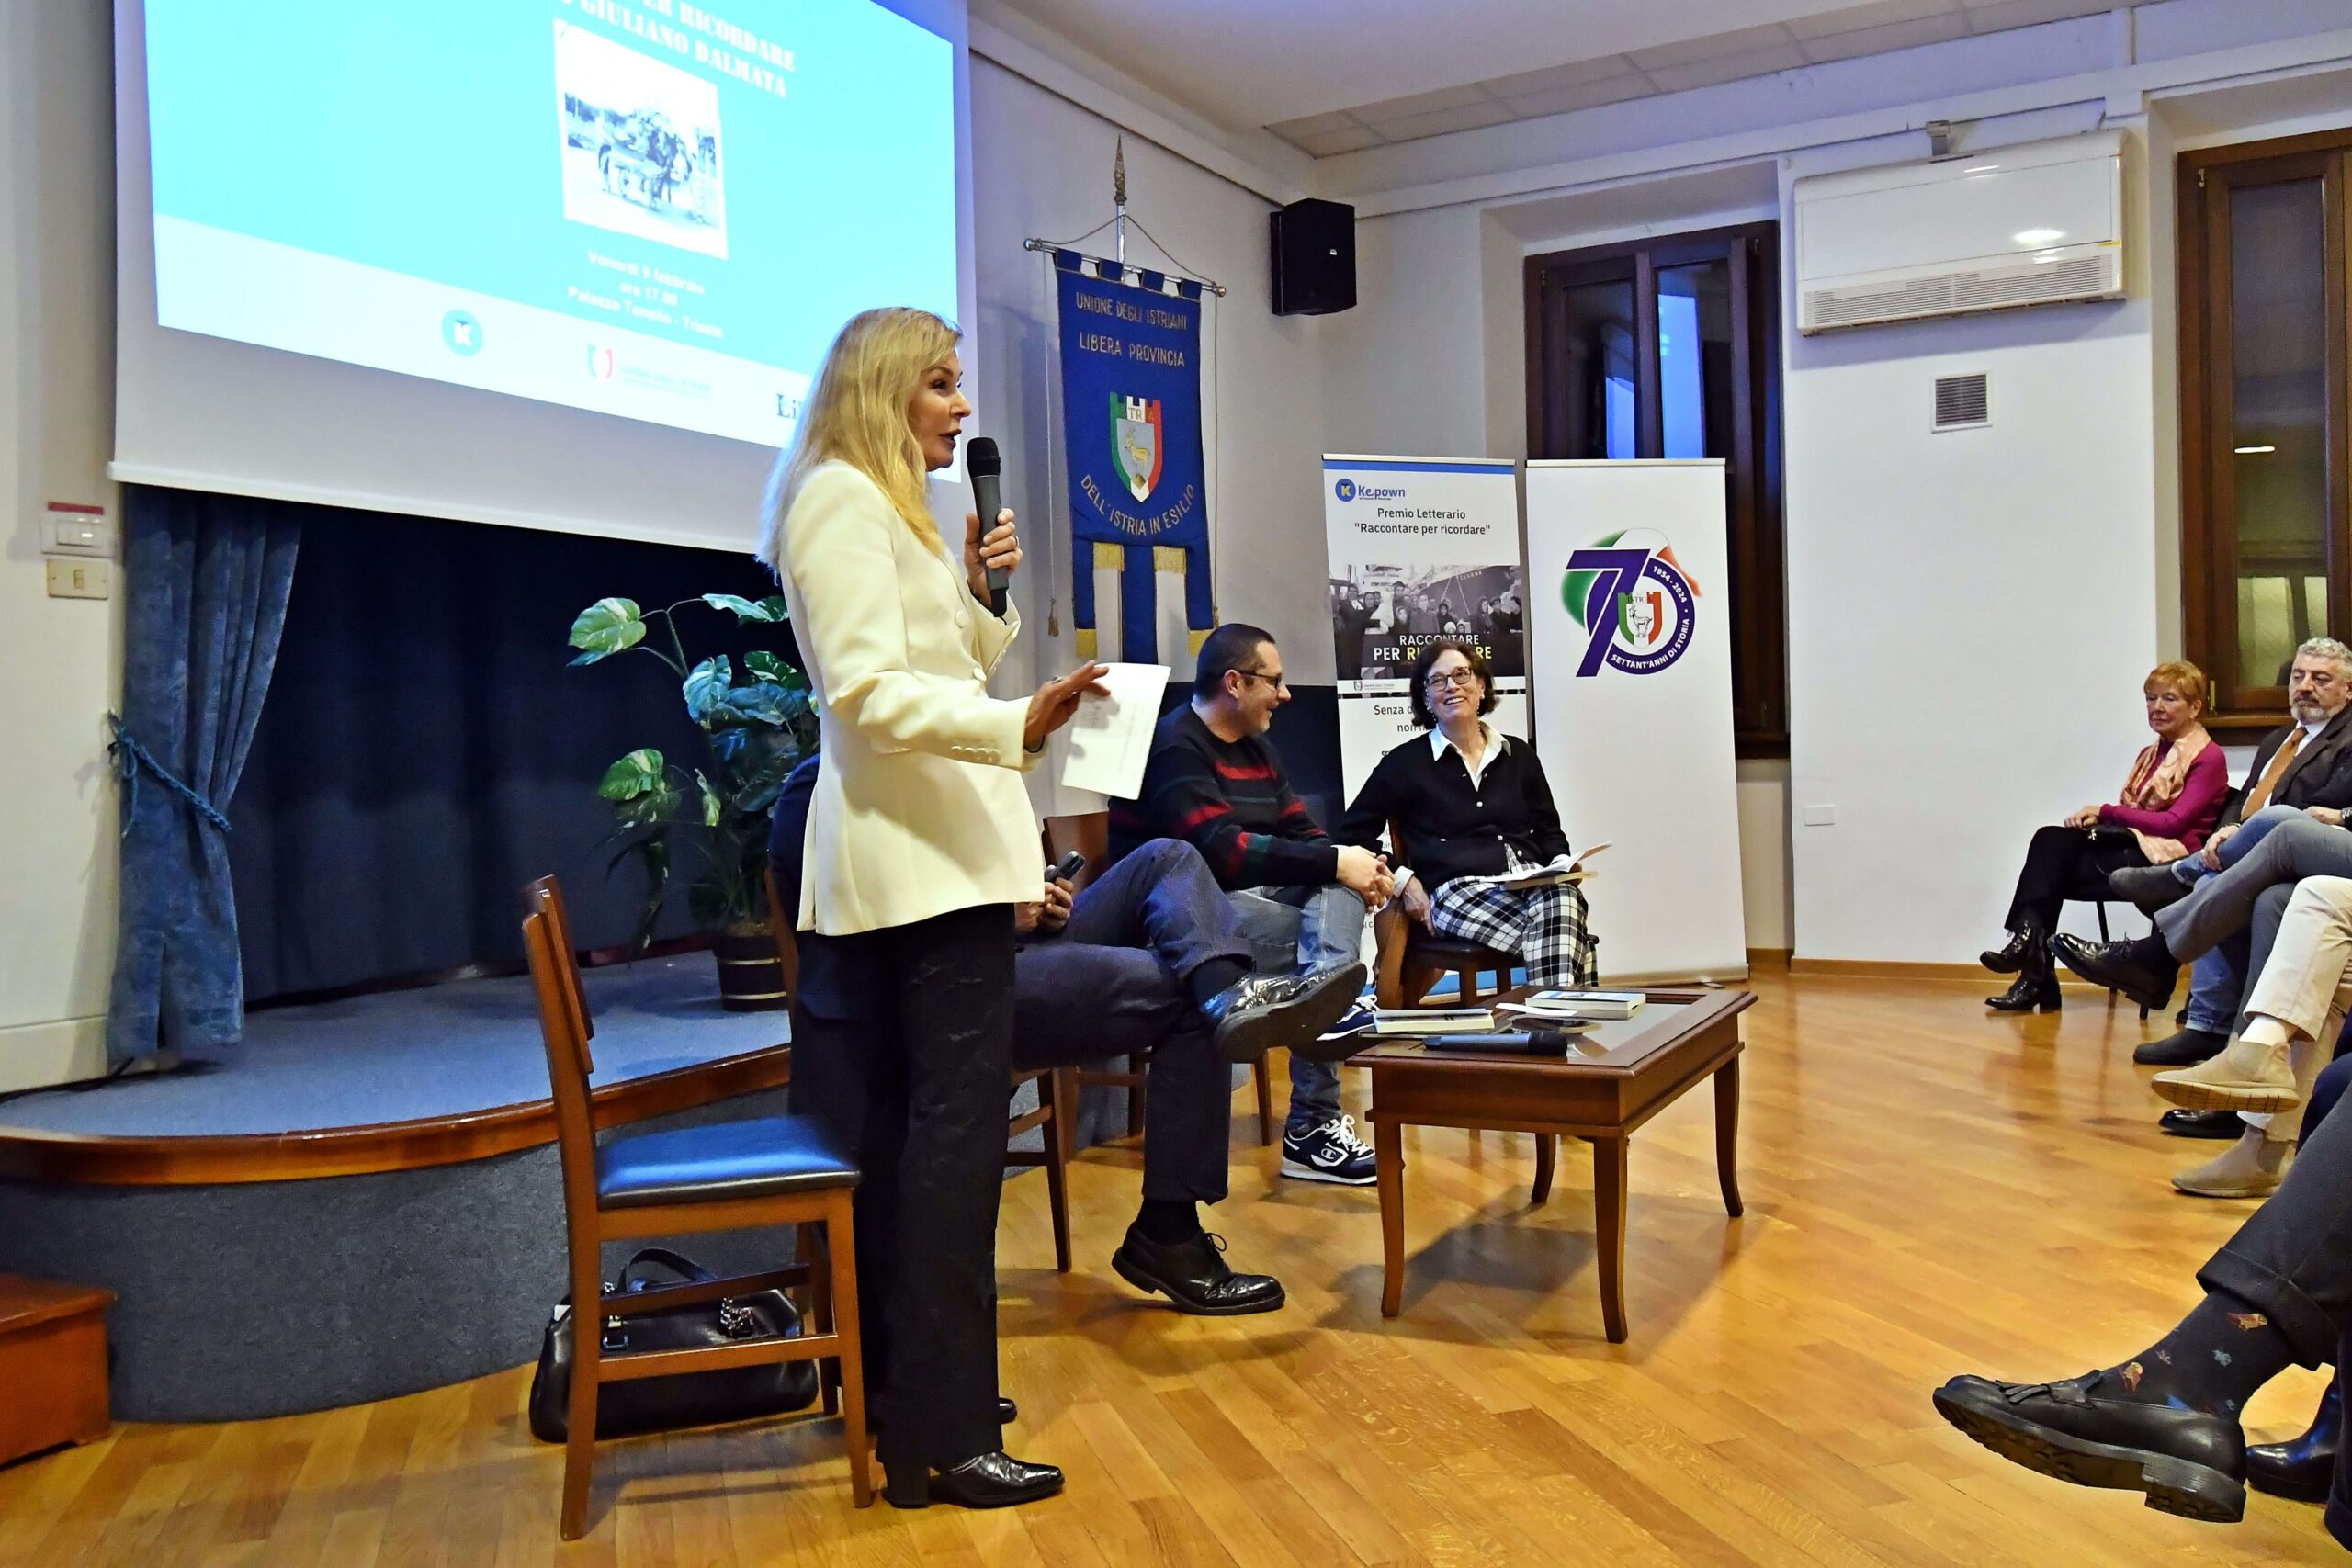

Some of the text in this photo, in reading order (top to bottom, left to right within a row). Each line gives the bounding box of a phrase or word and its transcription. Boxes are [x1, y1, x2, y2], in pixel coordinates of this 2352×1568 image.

[679, 1, 796, 73] RICORDARE
[695, 39, 787, 99] DALMATA
[1076, 291, 1187, 330] UNIONE DEGLI ISTRIANI
[1079, 332, 1185, 367] LIBERA PROVINCIA
[1150, 516, 1161, 535] IN
[1162, 484, 1193, 529] ESILIO
[1377, 508, 1466, 519] Premio Letterario
[1354, 523, 1490, 536] "Raccontare per ricordare"
[1654, 566, 1671, 581] 1954
[1672, 582, 1688, 603] 2024
[1374, 647, 1400, 660] PER
[1611, 618, 1690, 669] SETTANT'ANNI DI STORIA
[1374, 705, 1404, 715] Senza
